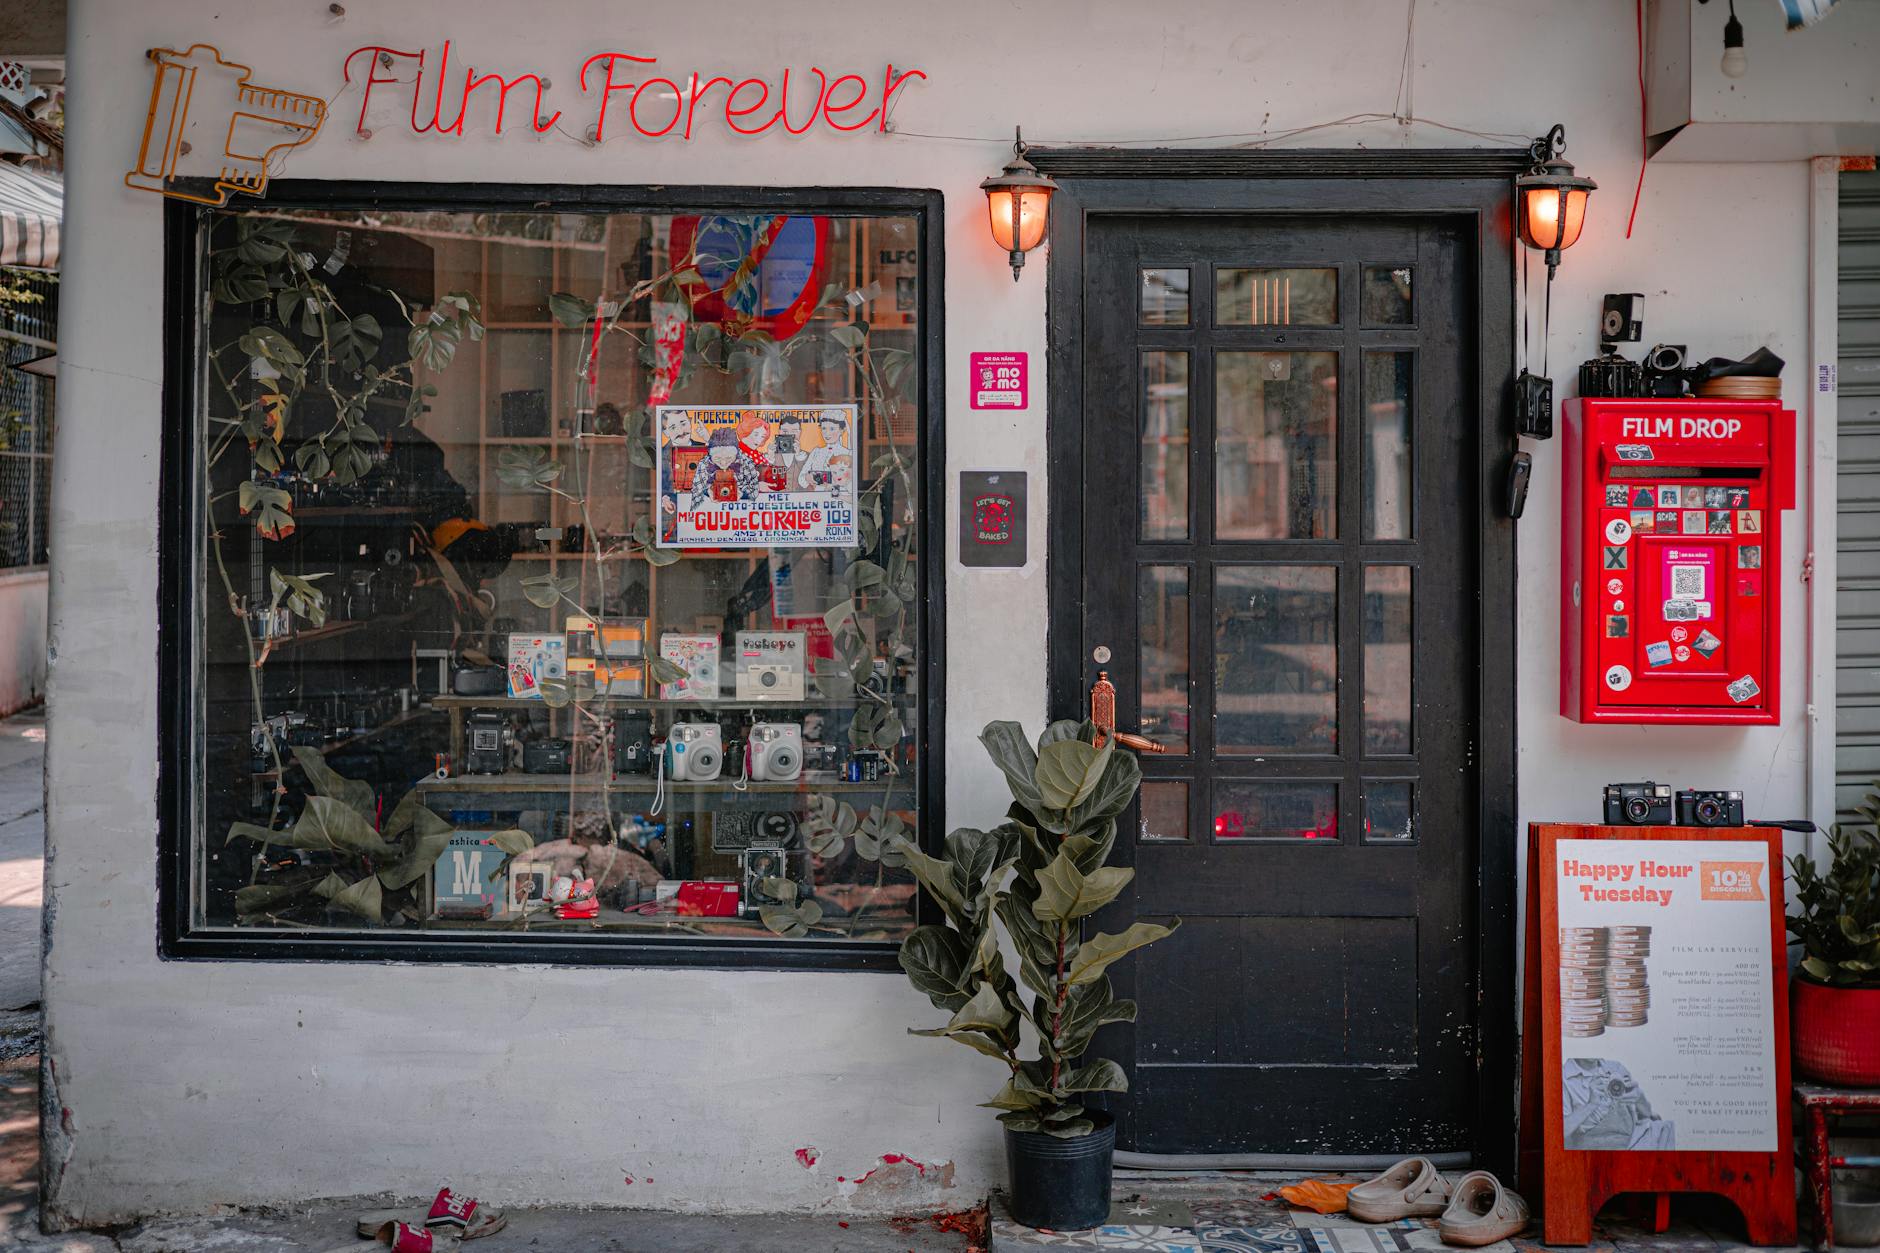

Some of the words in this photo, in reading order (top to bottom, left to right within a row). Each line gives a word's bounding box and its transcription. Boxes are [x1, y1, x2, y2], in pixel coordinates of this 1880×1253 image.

[343, 39, 562, 137] Film
[580, 52, 928, 142] Forever
[1622, 417, 1674, 438] FILM
[1680, 418, 1742, 439] DROP
[768, 493, 790, 501] MET
[823, 500, 844, 509] DER
[748, 510, 811, 531] CORAL
[827, 510, 851, 524] 109
[733, 530, 806, 538] AMSTERDAM
[826, 526, 852, 536] ROKIN
[979, 531, 1009, 541] BAKED
[449, 836, 480, 846] ashica
[453, 850, 483, 895] M
[1563, 860, 1634, 881] Happy
[1640, 860, 1693, 878] Hour
[1579, 884, 1673, 907] Tuesday
